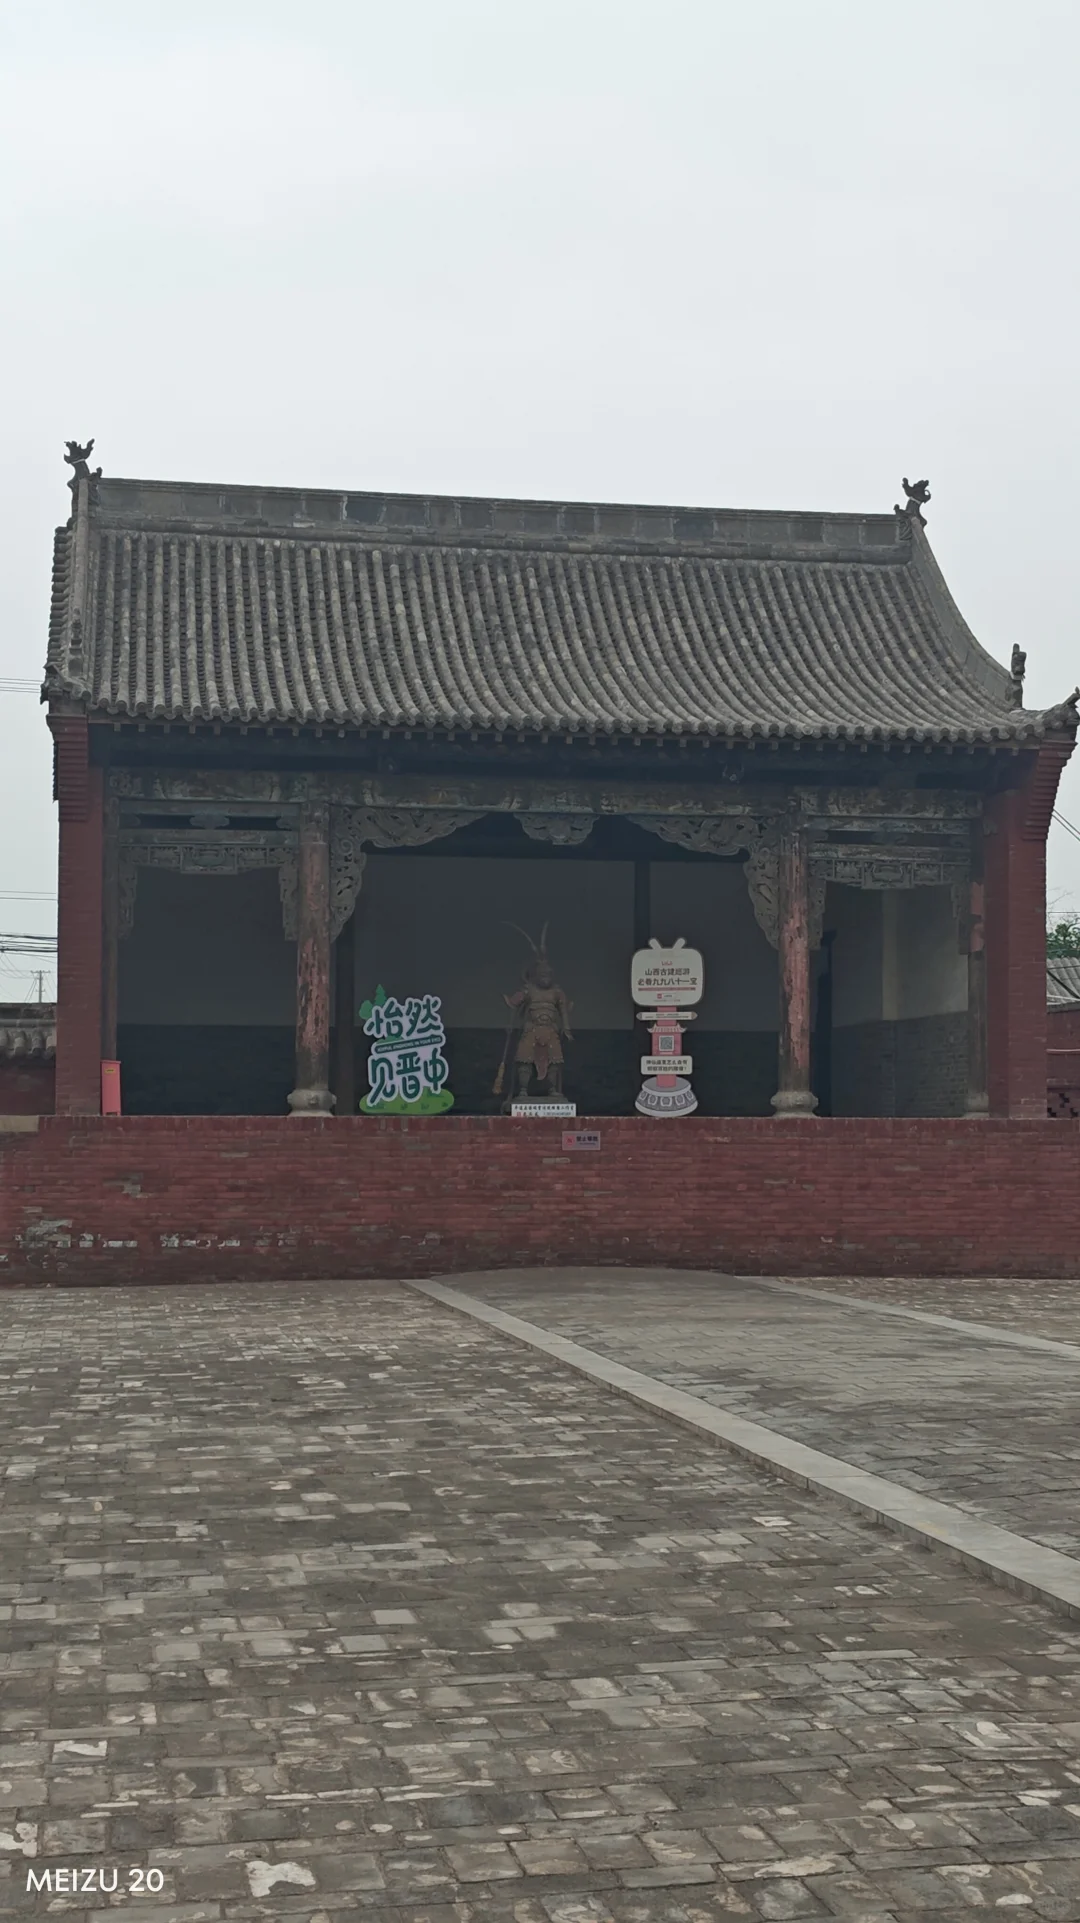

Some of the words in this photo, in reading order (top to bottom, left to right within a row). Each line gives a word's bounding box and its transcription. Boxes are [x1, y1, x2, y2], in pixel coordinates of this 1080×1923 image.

[637, 977, 698, 986] 必看九九八十一宝
[645, 968, 690, 976] 山西古建巡游
[366, 1000, 441, 1036] 怡然
[370, 1047, 446, 1103] 见晋中
